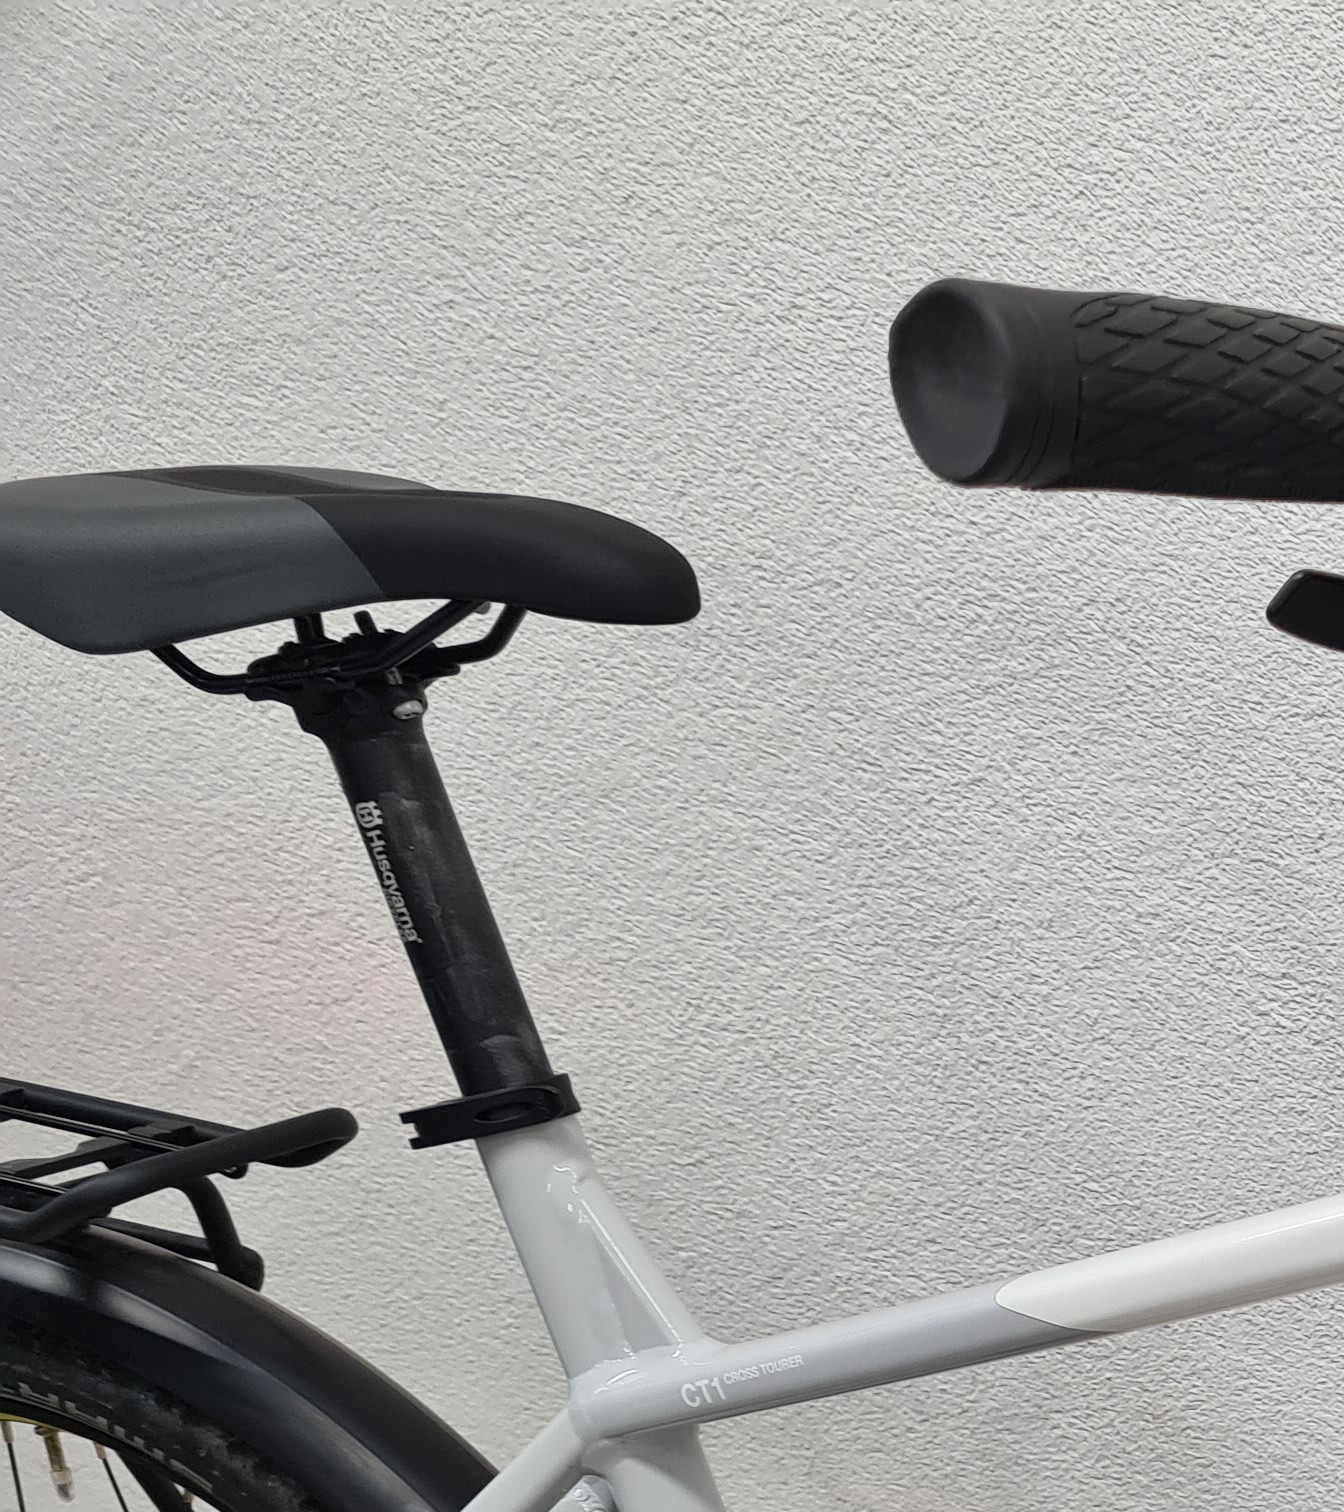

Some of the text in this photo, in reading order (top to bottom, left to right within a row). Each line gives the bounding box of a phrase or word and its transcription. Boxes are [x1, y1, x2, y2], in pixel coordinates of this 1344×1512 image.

[365, 829, 424, 943] Husqvarna
[680, 1354, 805, 1408] CT1 CROSS TOURER
